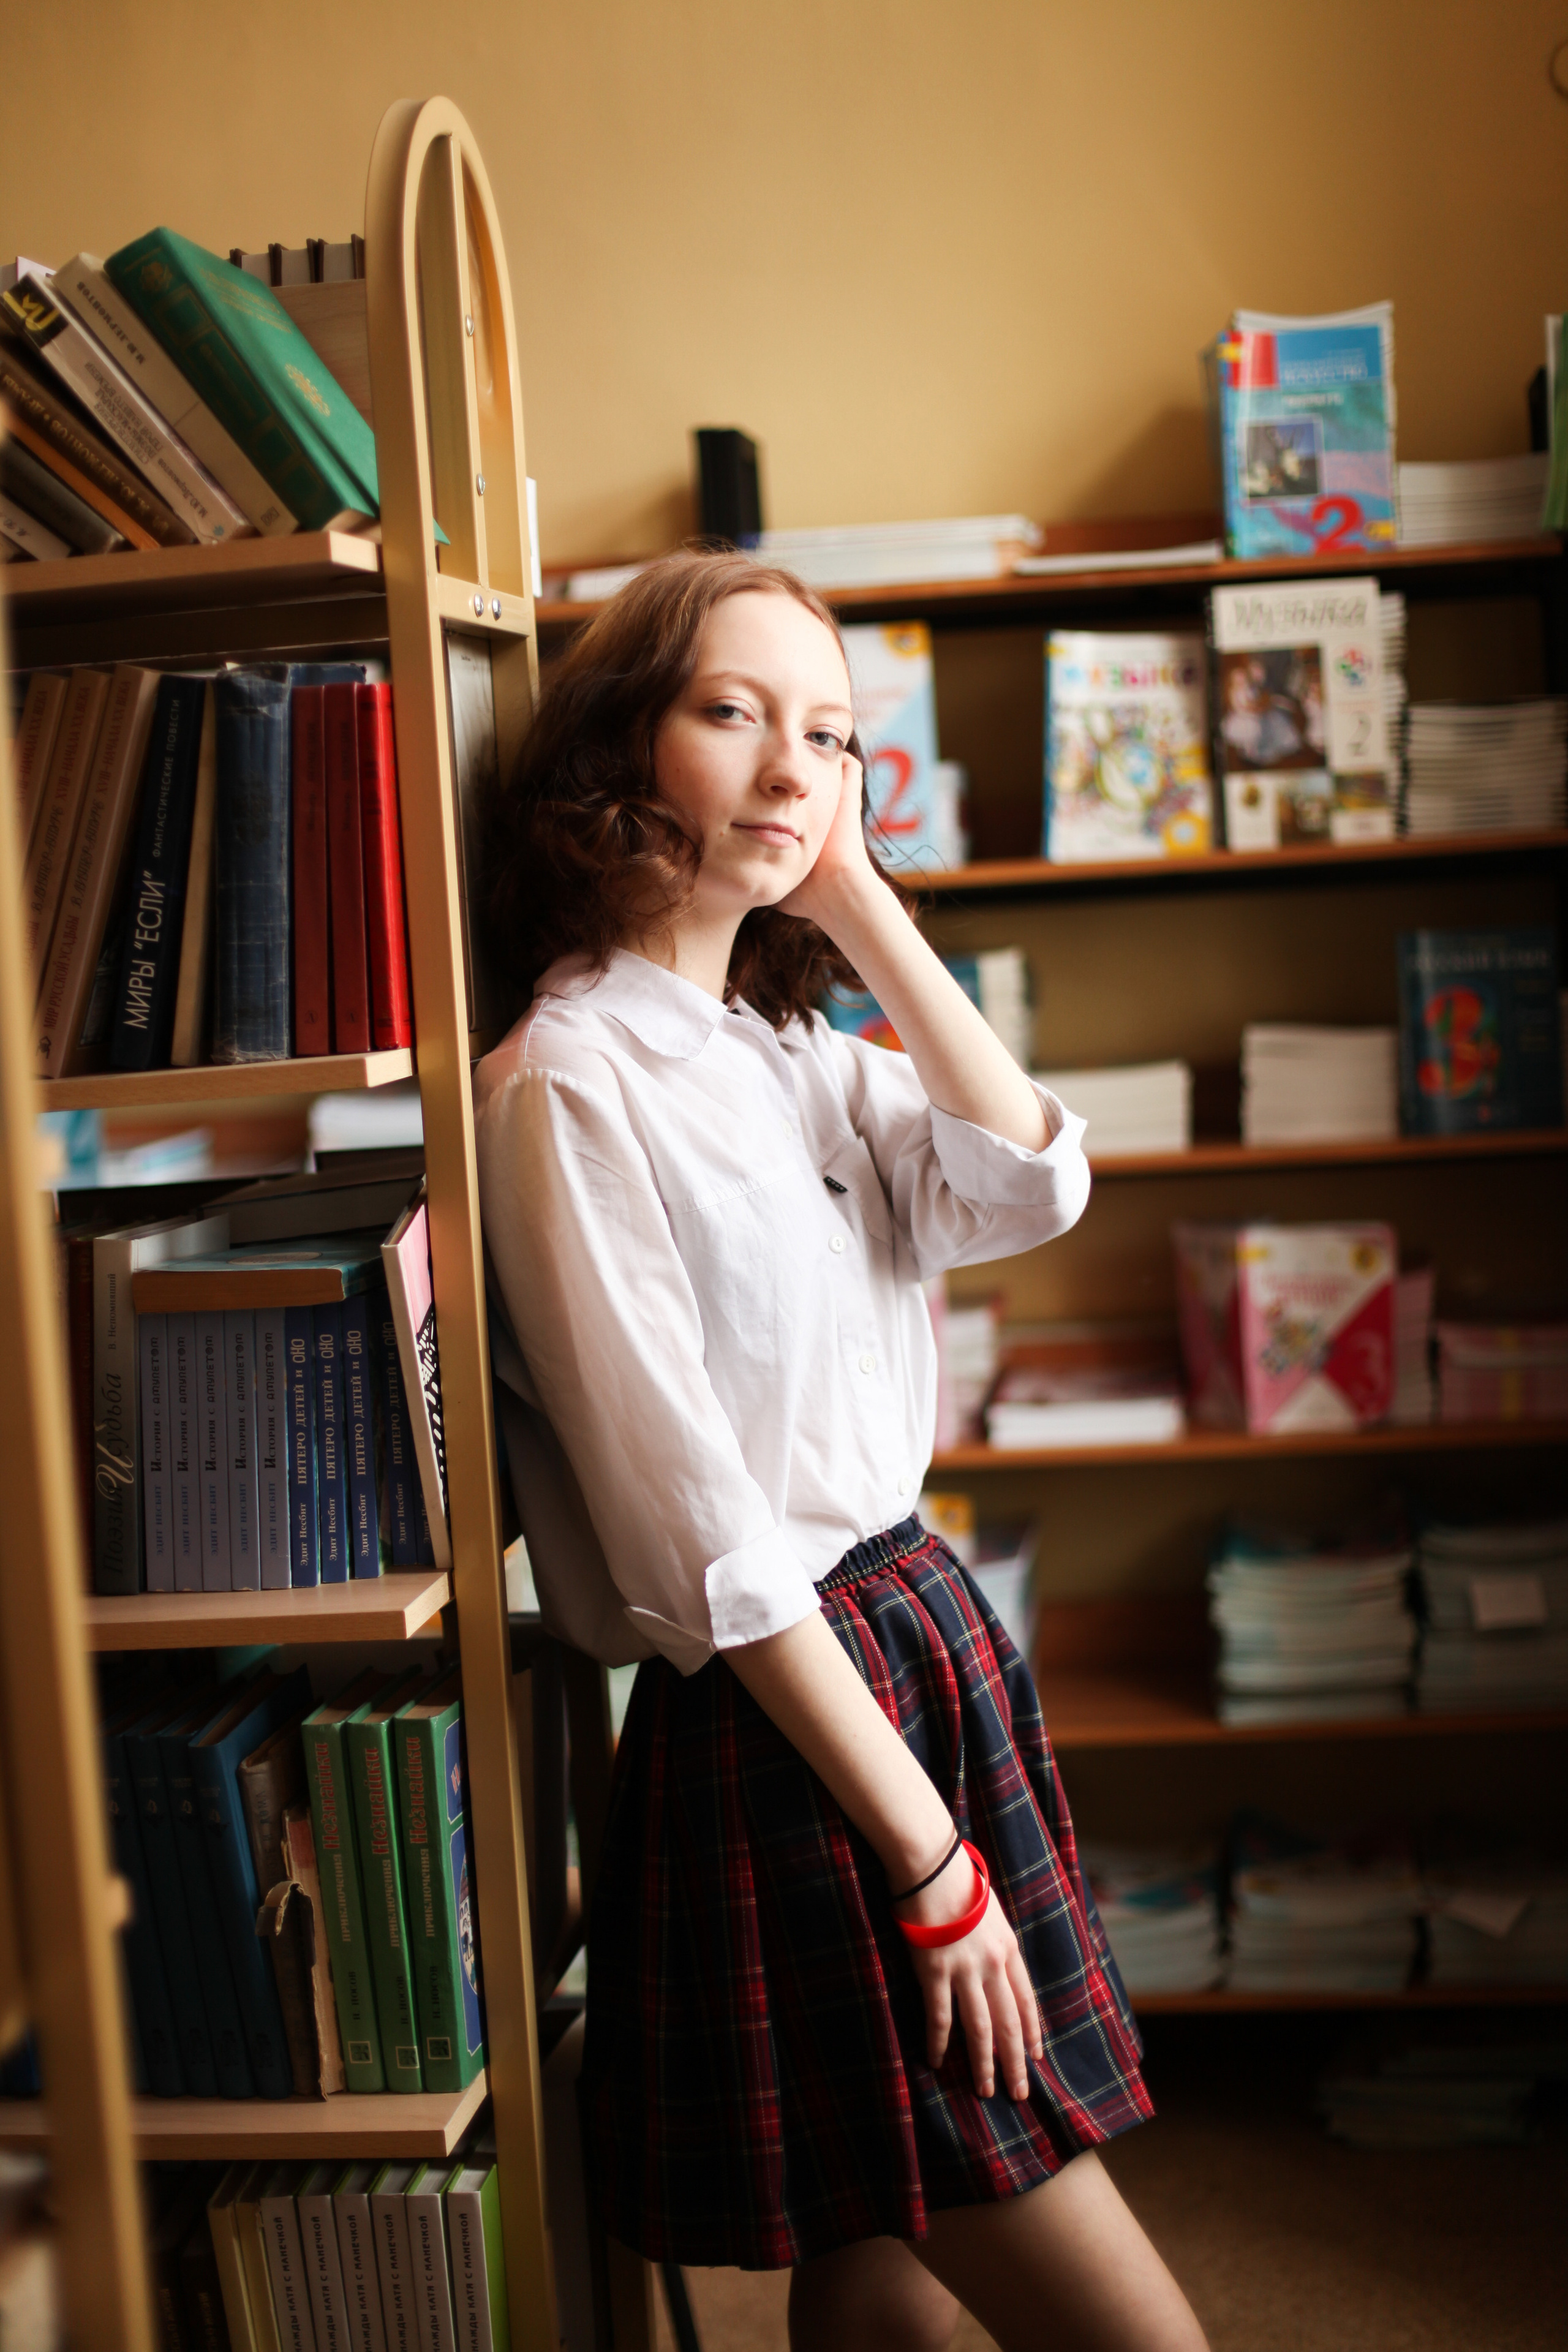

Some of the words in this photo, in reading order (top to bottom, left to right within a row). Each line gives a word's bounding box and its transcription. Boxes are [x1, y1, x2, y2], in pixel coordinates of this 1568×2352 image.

[84, 361, 116, 398] ВРЕМЕНИ
[113, 396, 143, 428] НАШЕГО
[140, 426, 164, 453] ГЕРОЙ
[1311, 494, 1366, 556] 2
[74, 687, 91, 714] ВЕКА
[115, 679, 131, 706] ВЕКА
[873, 746, 922, 834] 2
[123, 960, 156, 1030] МИРЫ
[152, 756, 173, 857] ФАНТАСТИЧЕСКИЕ
[165, 699, 181, 752] ПОВЕСТИ
[59, 914, 80, 961] УСАДЬБЫ
[47, 962, 70, 1008] РУССКОЙ
[43, 1008, 59, 1030] МИР
[108, 1341, 117, 1349] В.
[290, 1338, 306, 1363] ОНО
[318, 1334, 334, 1359] ОНО
[347, 1330, 363, 1355] ОНО
[101, 1373, 129, 1457] судьба
[293, 1384, 307, 1427] ДЕТЕЙ
[322, 1380, 336, 1422] ДЕТЕЙ
[350, 1376, 364, 1418] ДЕТЕЙ
[296, 1432, 307, 1484] ПЯТЕРО
[325, 1427, 336, 1480] ПЯТЕРО
[354, 1423, 366, 1476] ПЯТЕРО
[102, 1484, 123, 1575] Поэзия
[298, 1503, 307, 1538] Несбит
[327, 1498, 336, 1533] Несбит
[358, 1493, 368, 1529] Несбит
[299, 1542, 309, 1566] Эдит
[328, 1537, 337, 1561] Эдит
[360, 1532, 369, 1556] Эдит
[314, 1743, 341, 1849] Незнайки
[363, 1747, 390, 1854] Незнайки
[404, 1736, 429, 1844] Незнайки
[347, 1971, 360, 2006] НОСОВ
[396, 1976, 407, 2010] НОСОВ
[429, 1966, 440, 2005] НОСОВ
[273, 2217, 290, 2271] МАНЕЧКОЙ
[311, 2216, 326, 2271] МАНЕЧКОЙ
[347, 2215, 363, 2270] МАНЕЧКОЙ
[383, 2214, 398, 2269] МАНЕЧКОЙ
[418, 2215, 433, 2271] МАНЕЧКОЙ
[459, 2213, 472, 2269] МАНЕЧКОЙ
[285, 2285, 297, 2311] КАТЯ
[320, 2285, 333, 2310] КАТЯ
[356, 2284, 368, 2310] КАТЯ
[392, 2283, 404, 2309] КАТЯ
[426, 2285, 437, 2311] КАТЯ
[465, 2283, 476, 2309] КАТЯ
